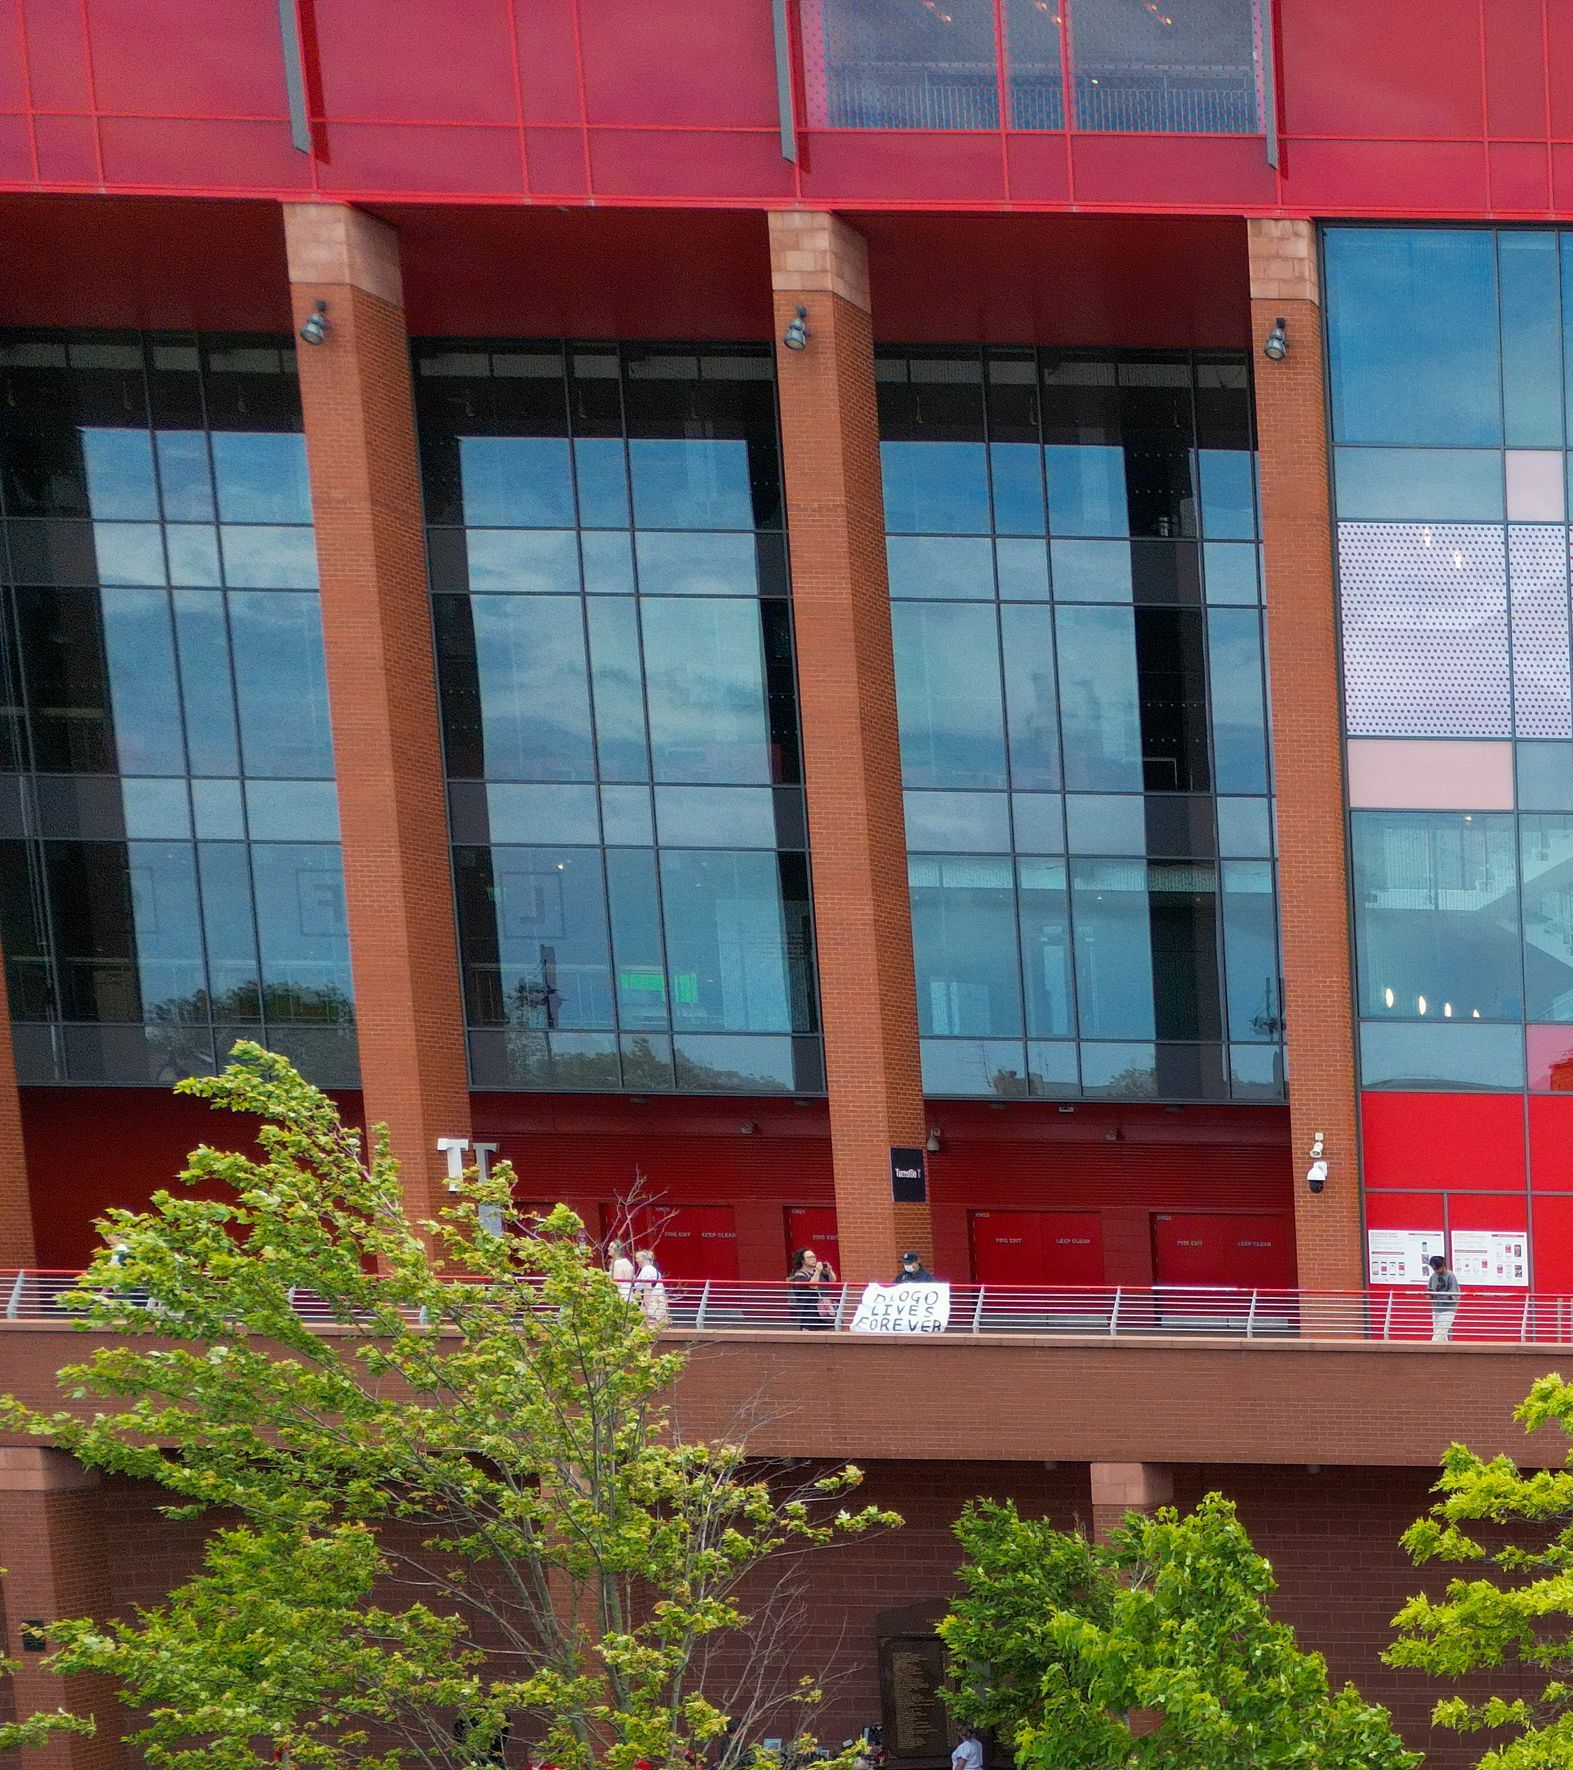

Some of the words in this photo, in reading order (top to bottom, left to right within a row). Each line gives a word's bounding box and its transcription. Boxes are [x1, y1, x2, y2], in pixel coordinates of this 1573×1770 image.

[873, 1290, 940, 1305] DIOGO
[870, 1304, 935, 1319] LIVES
[856, 1317, 943, 1334] FOREVER
